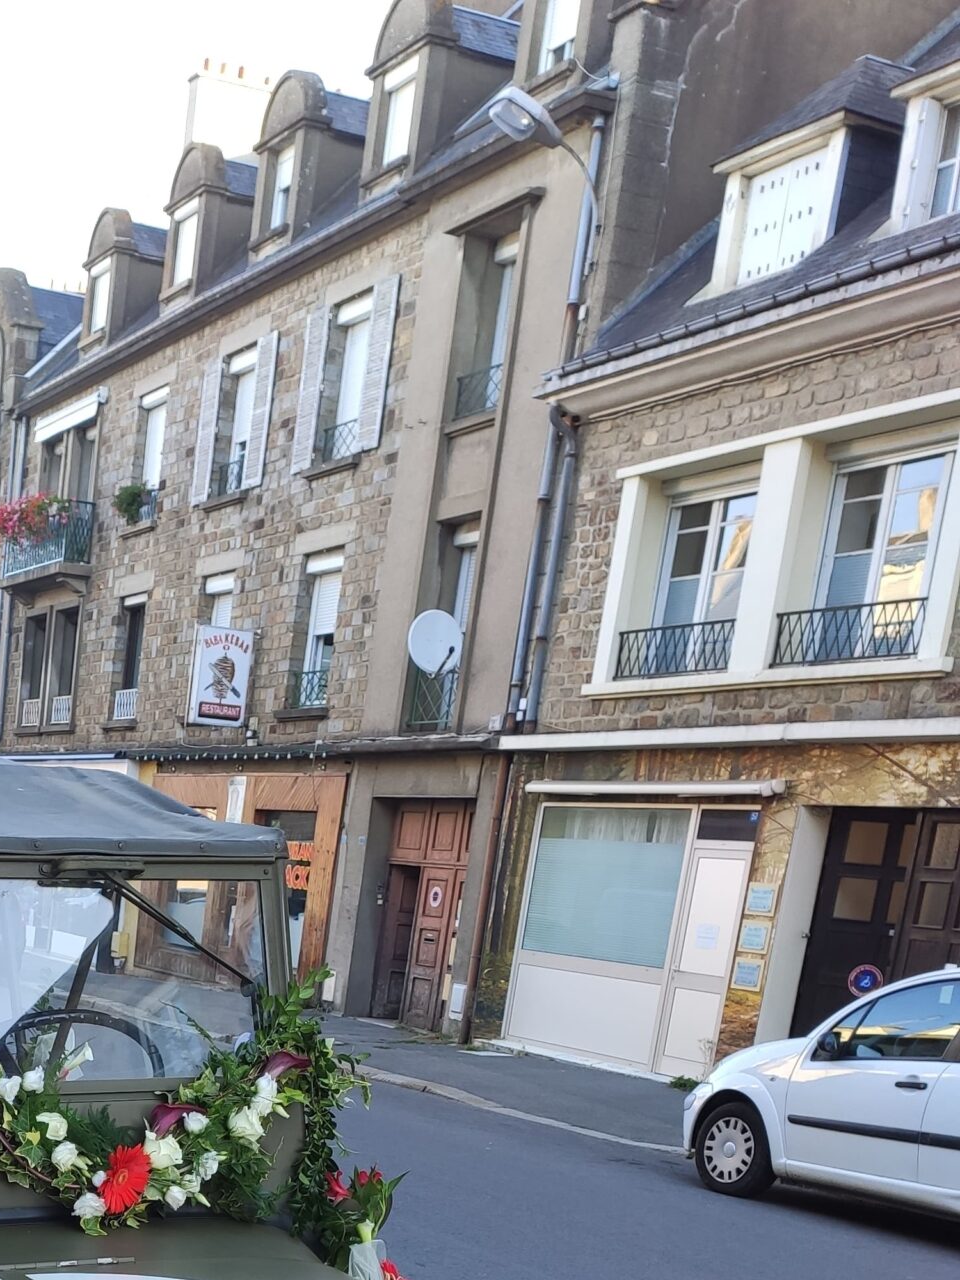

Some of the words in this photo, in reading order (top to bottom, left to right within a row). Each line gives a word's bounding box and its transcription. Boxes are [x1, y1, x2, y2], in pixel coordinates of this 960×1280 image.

[203, 635, 224, 649] BABA
[224, 633, 251, 655] KEBAB
[201, 702, 242, 717] RESTAURANT
